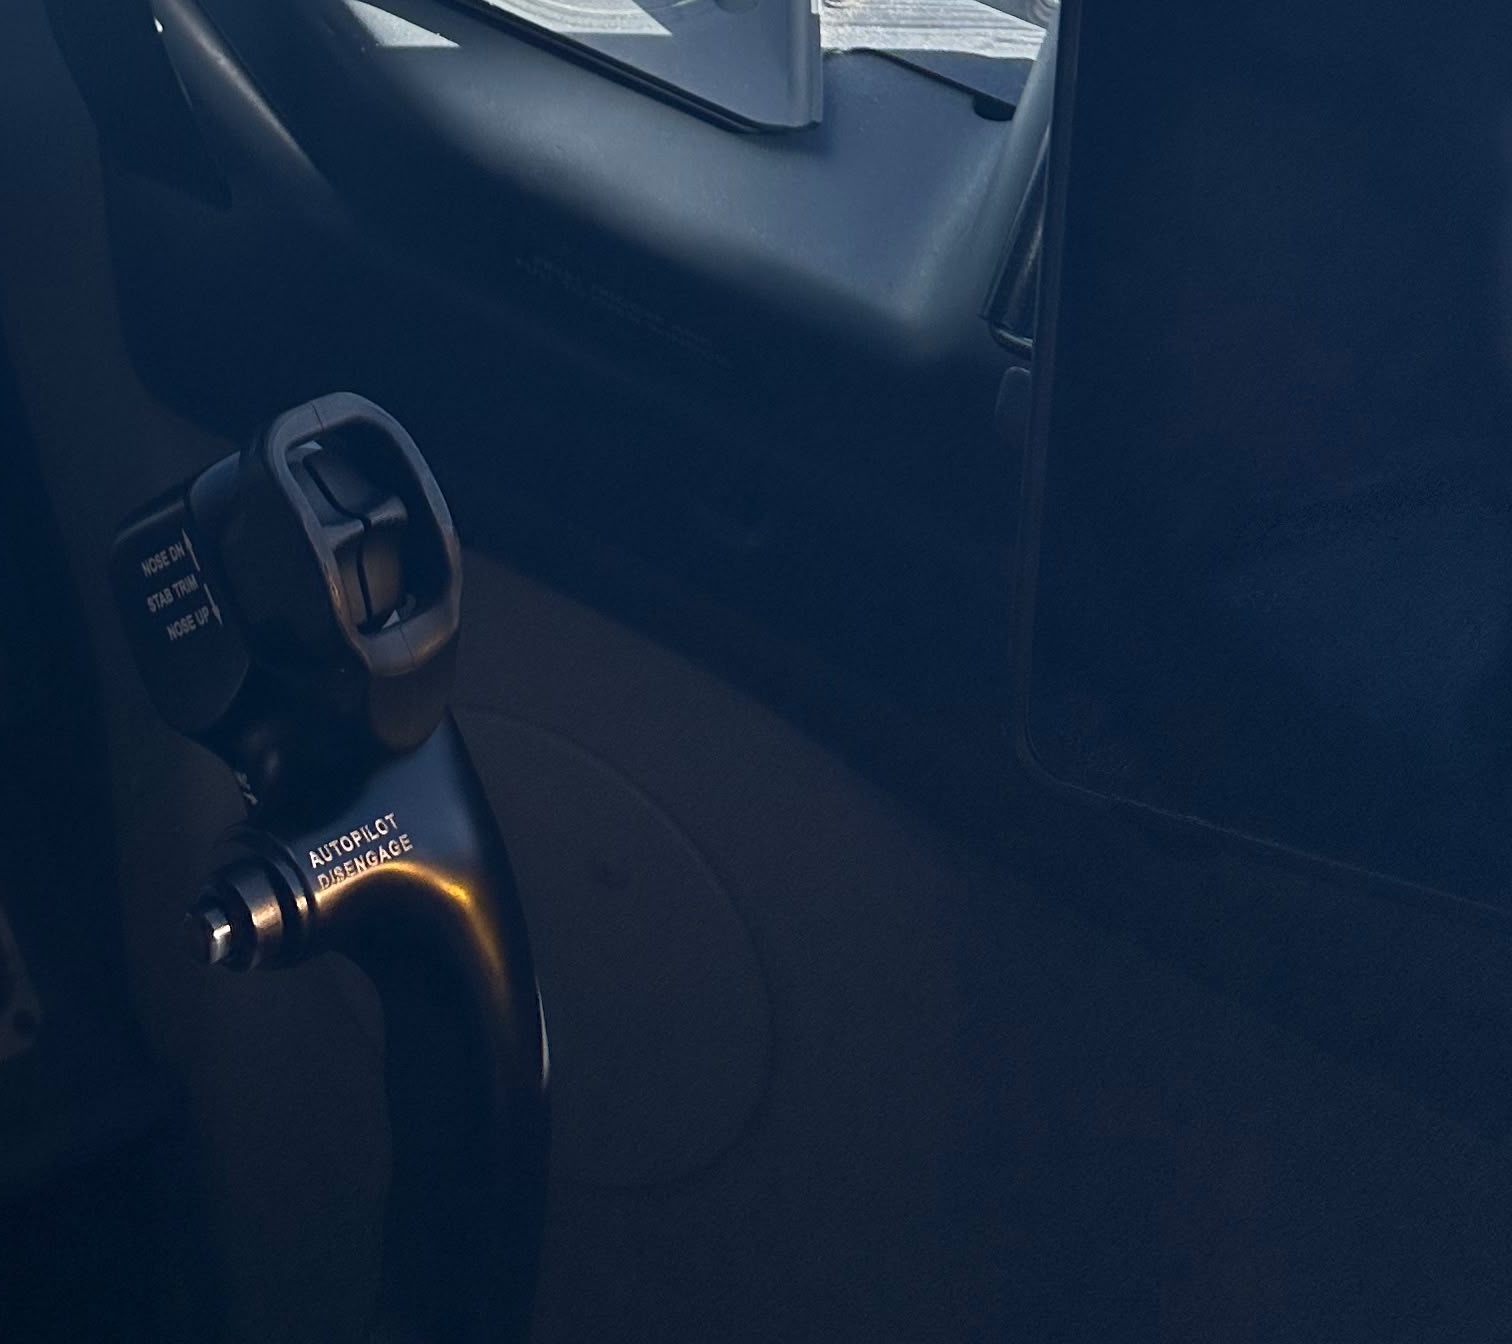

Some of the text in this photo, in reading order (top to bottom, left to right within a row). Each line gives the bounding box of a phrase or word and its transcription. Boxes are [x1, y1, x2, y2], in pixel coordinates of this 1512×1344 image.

[141, 550, 170, 576] NOSE
[147, 573, 199, 613] STAB TRIM
[167, 605, 209, 640] NOSE UP
[308, 812, 398, 869] AUTOPILOT
[317, 834, 413, 889] DISENGAGE
